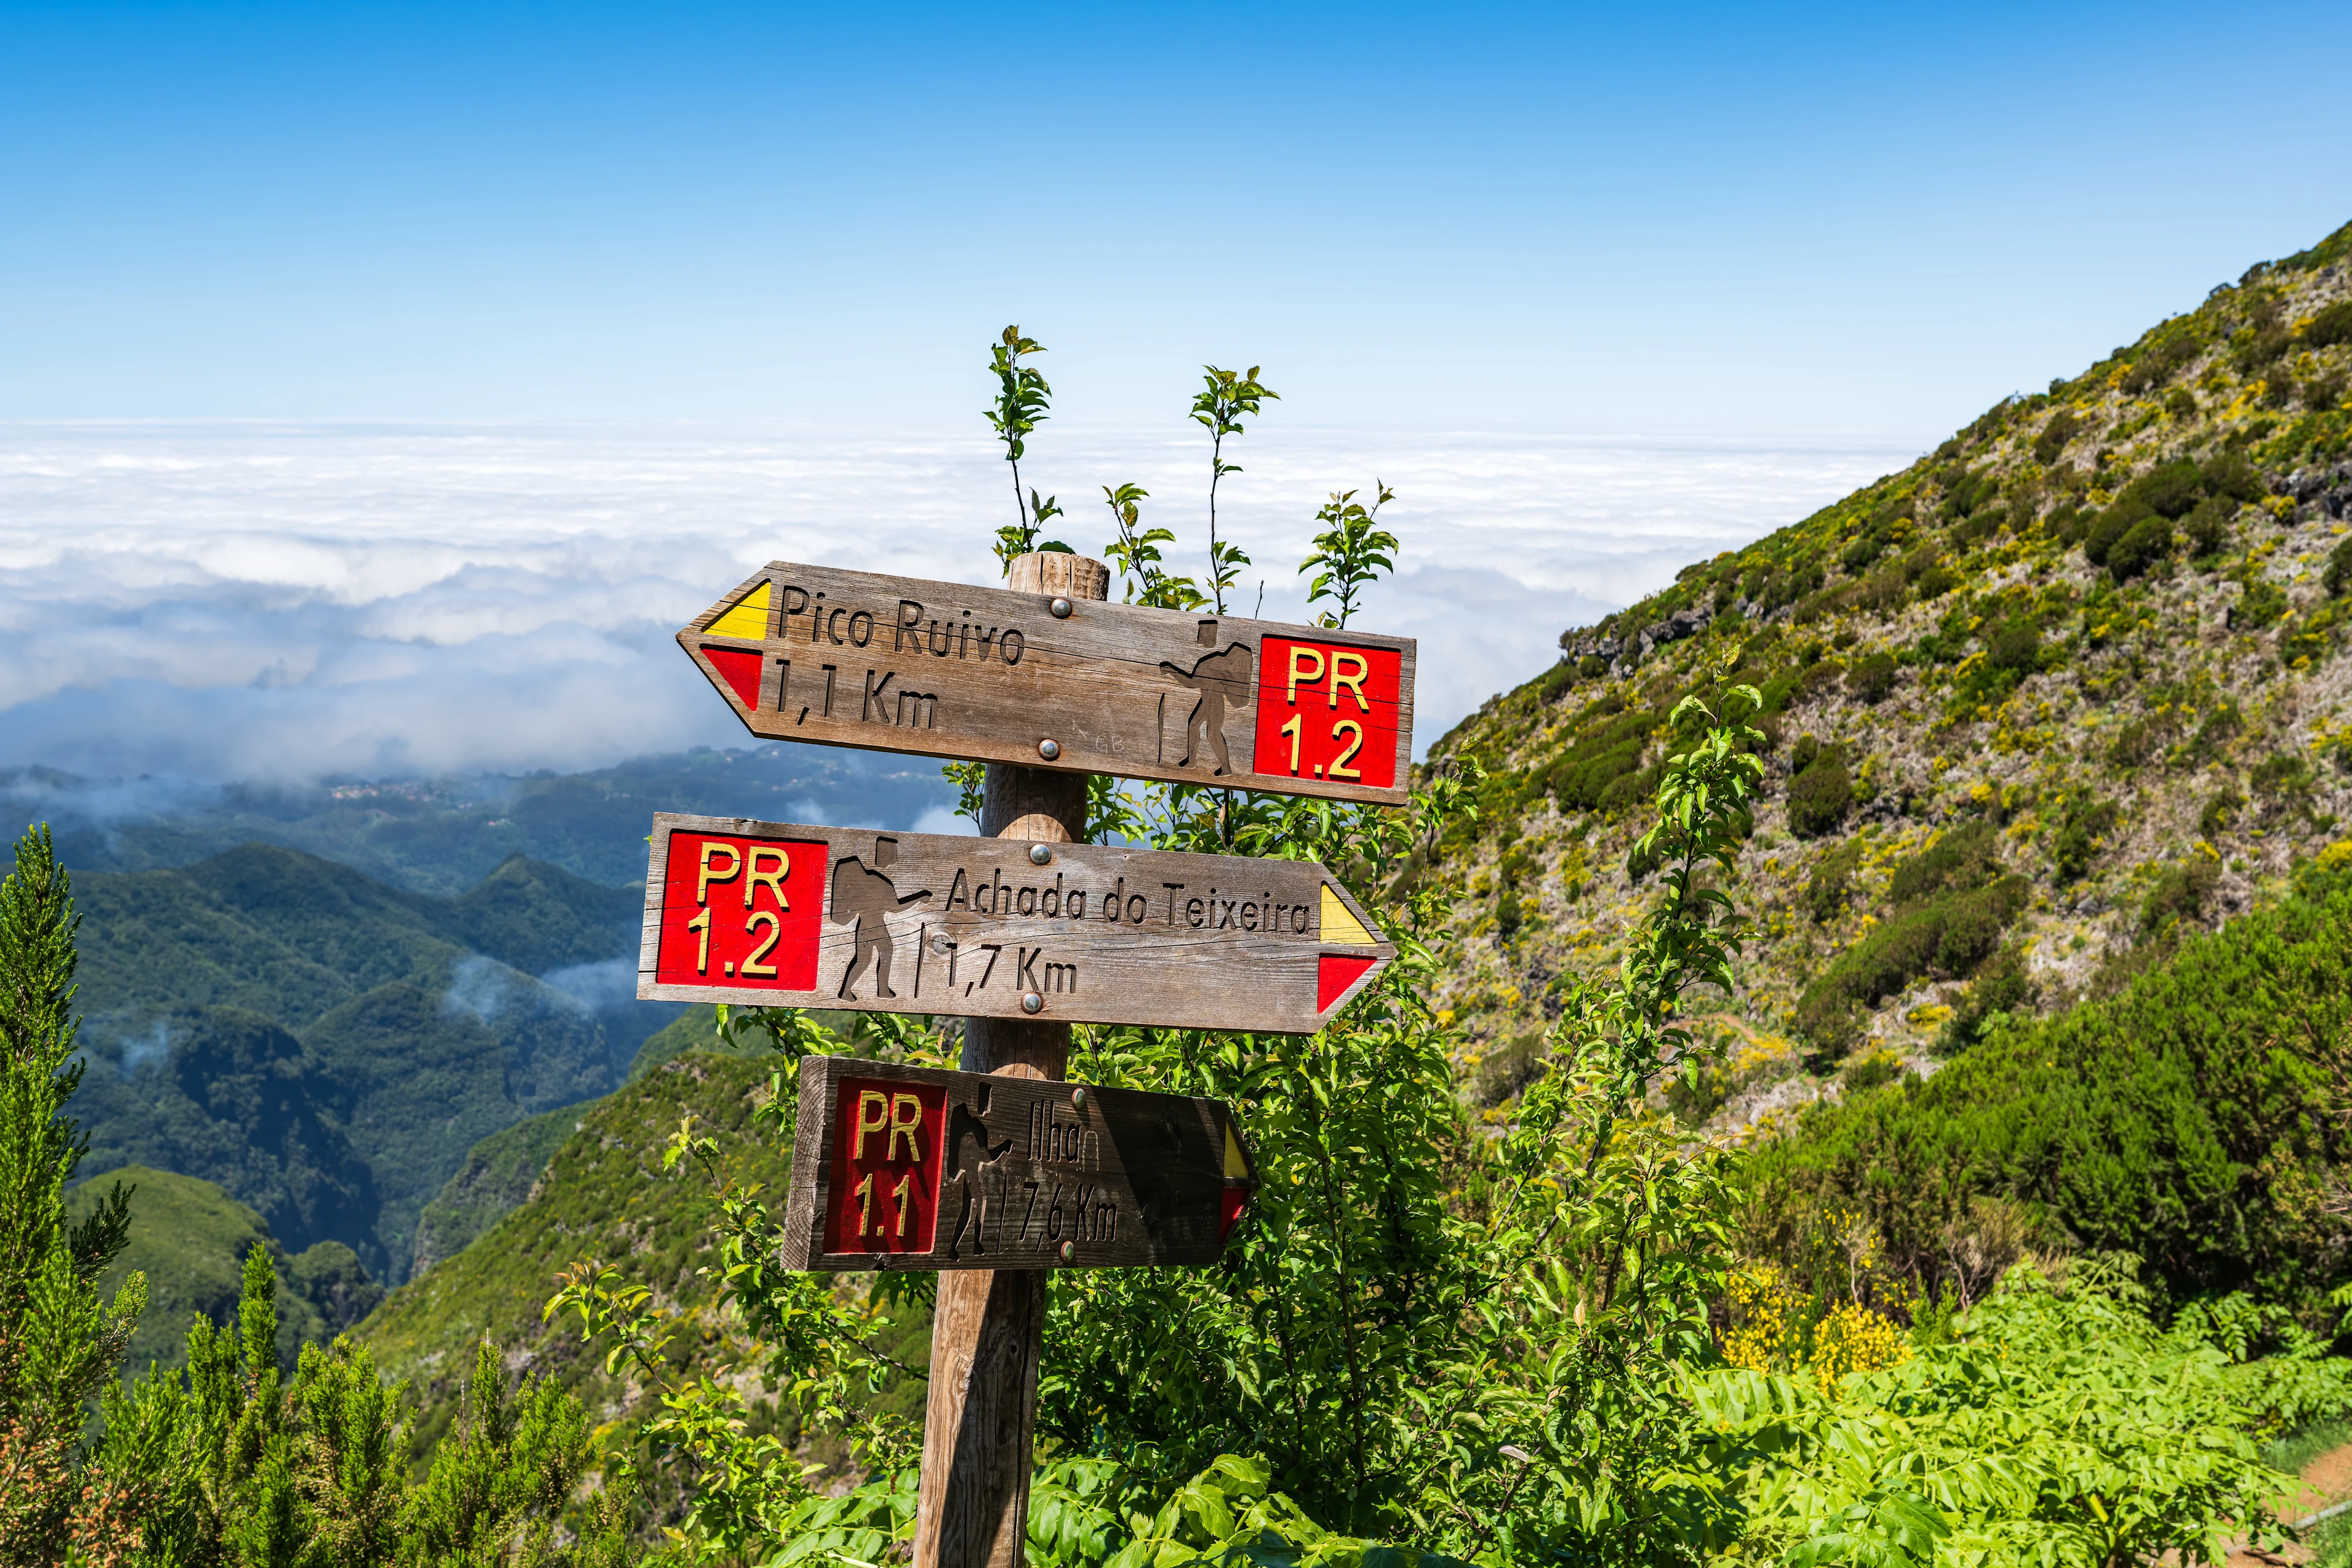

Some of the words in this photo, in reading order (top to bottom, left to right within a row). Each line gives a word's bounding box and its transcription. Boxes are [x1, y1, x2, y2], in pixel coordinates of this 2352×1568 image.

[778, 585, 874, 649] Pico
[894, 599, 1025, 666] Ruivo
[775, 658, 837, 726] 1,1
[862, 669, 938, 729] Km
[1287, 646, 1370, 712] PR
[1281, 714, 1363, 778] 1.2
[696, 842, 790, 910] PR
[944, 867, 1087, 920] Achada
[1103, 876, 1148, 924] do
[1163, 882, 1310, 935] Teixeira
[687, 907, 778, 976] 1.2
[948, 942, 1002, 998] 1,7
[1016, 946, 1077, 994] Km
[854, 1090, 922, 1162] PR
[854, 1173, 910, 1237] 1.1
[1019, 1182, 1064, 1253] 7,6
[1074, 1183, 1118, 1242] Km
